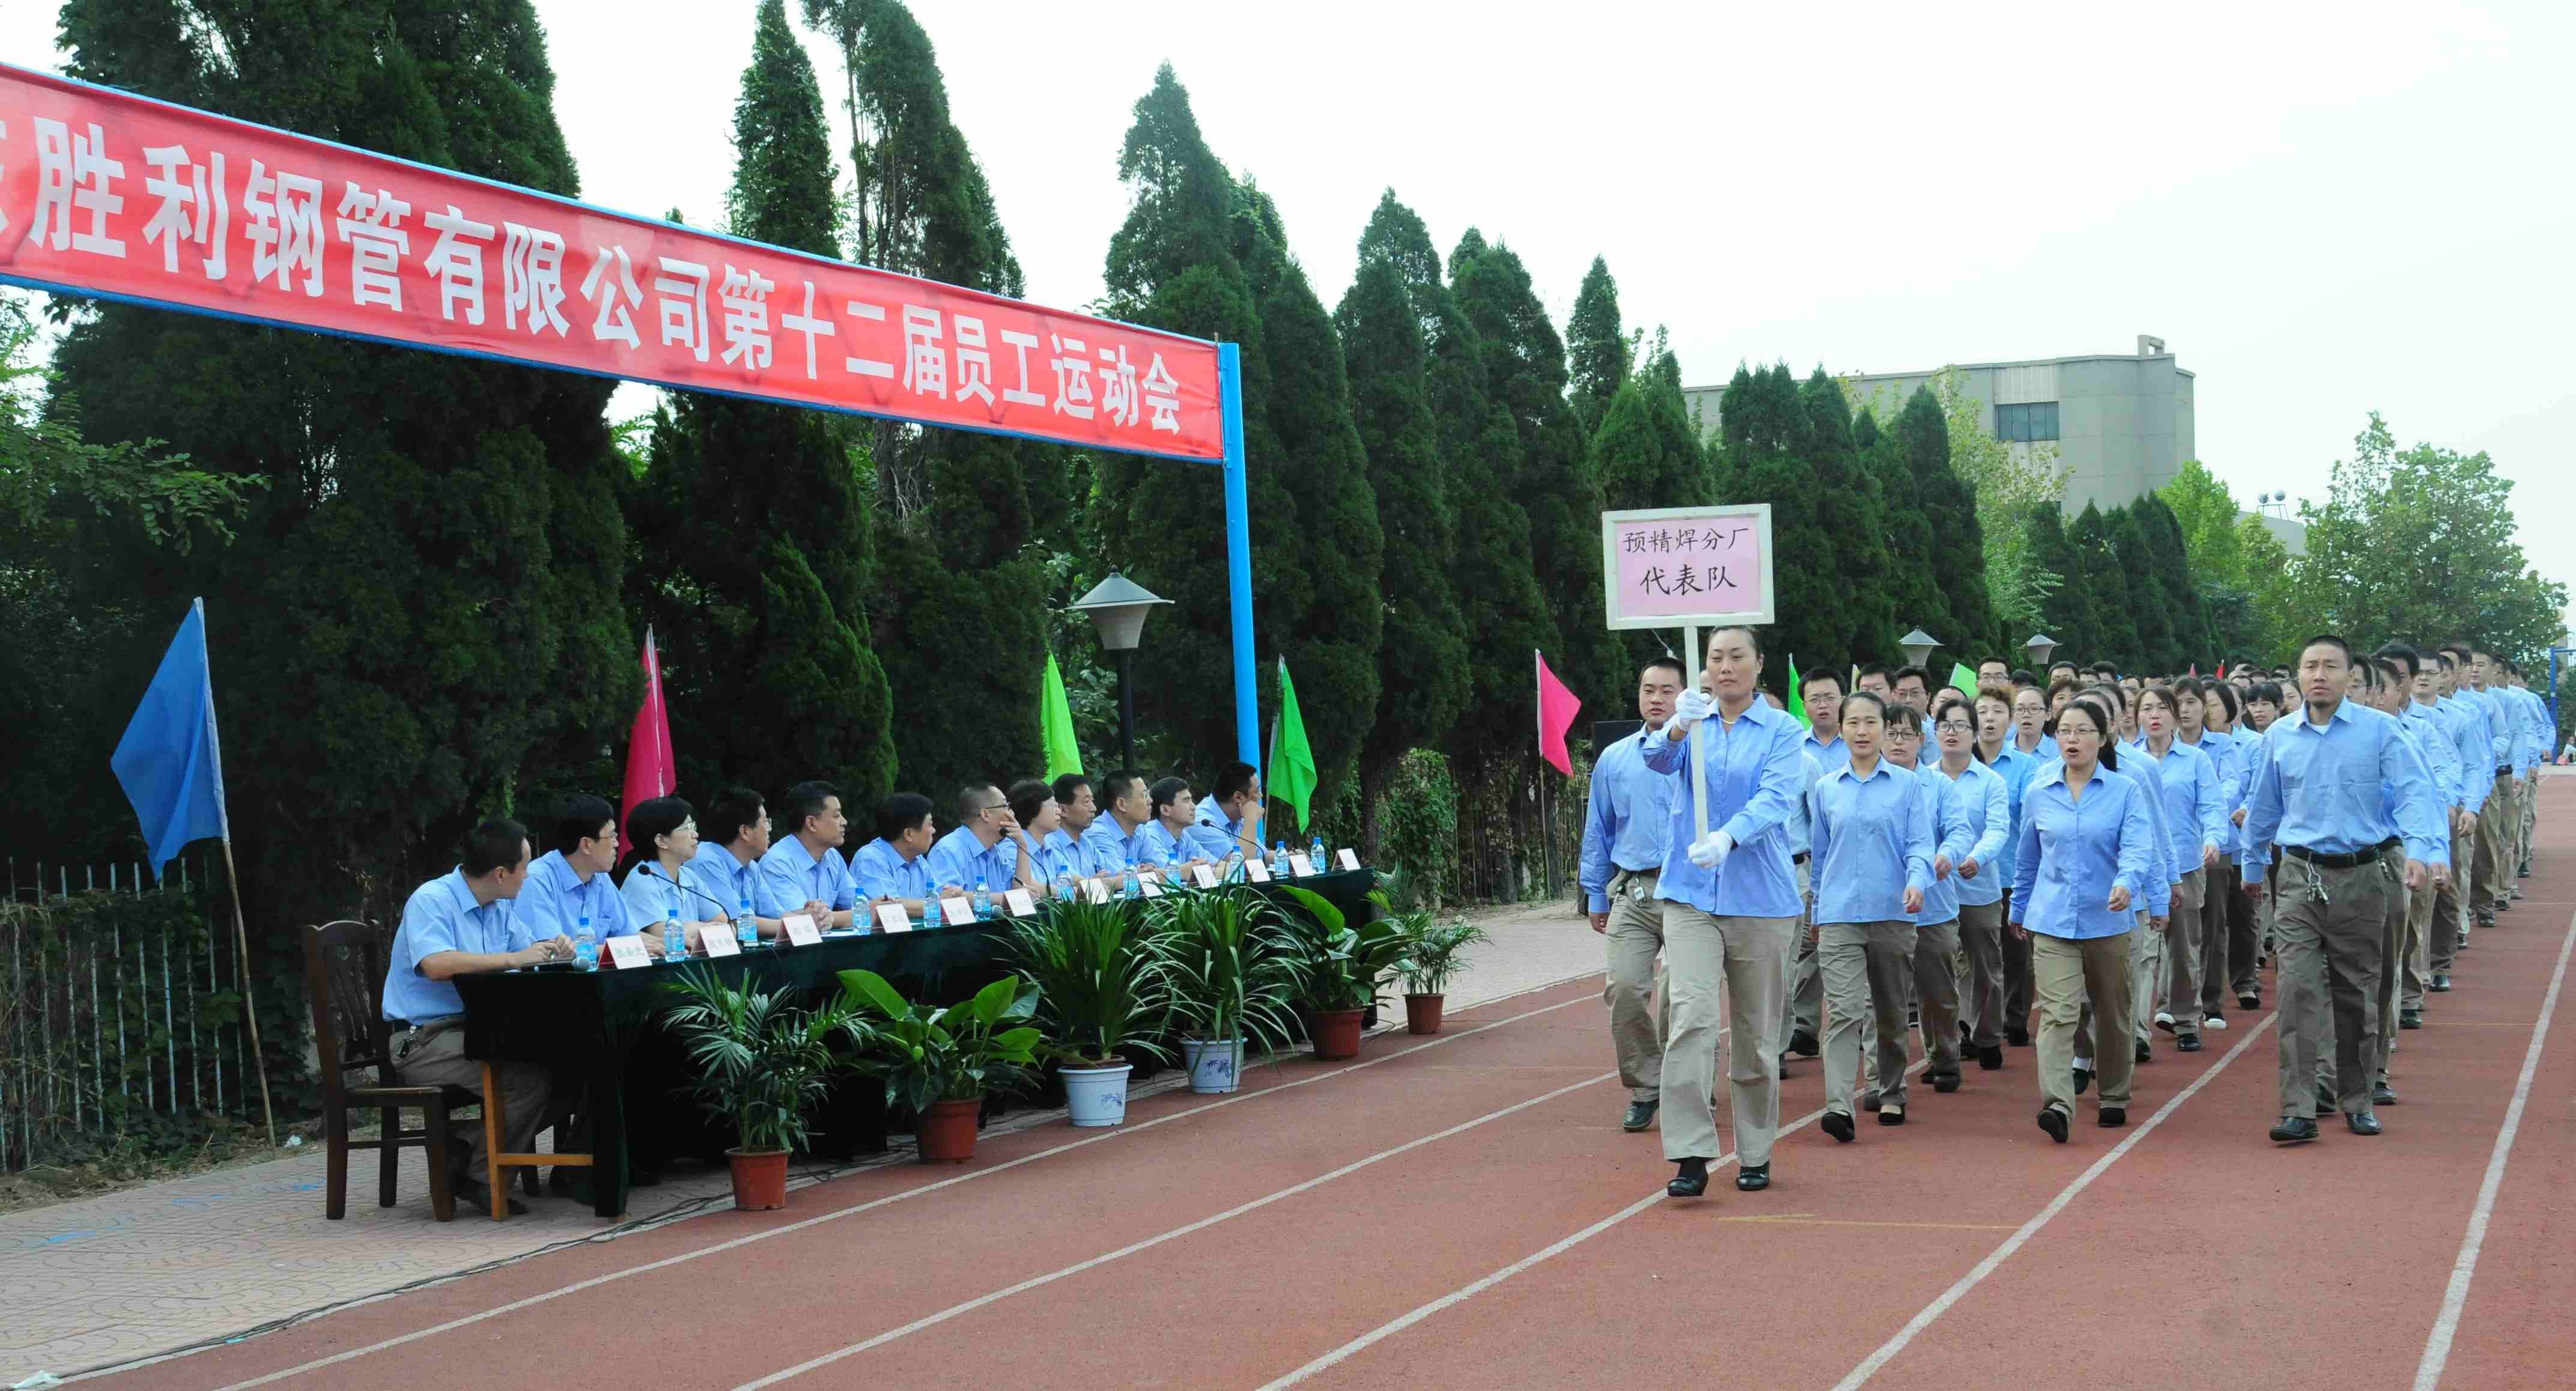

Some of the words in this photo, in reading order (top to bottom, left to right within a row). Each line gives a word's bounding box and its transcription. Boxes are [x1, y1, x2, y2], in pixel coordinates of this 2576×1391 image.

[0, 115, 1180, 436] 胜利钢管有限公司第十二届员工运动会
[1623, 528, 1749, 553] 预精焊分厂
[1639, 564, 1738, 596] 代表队
